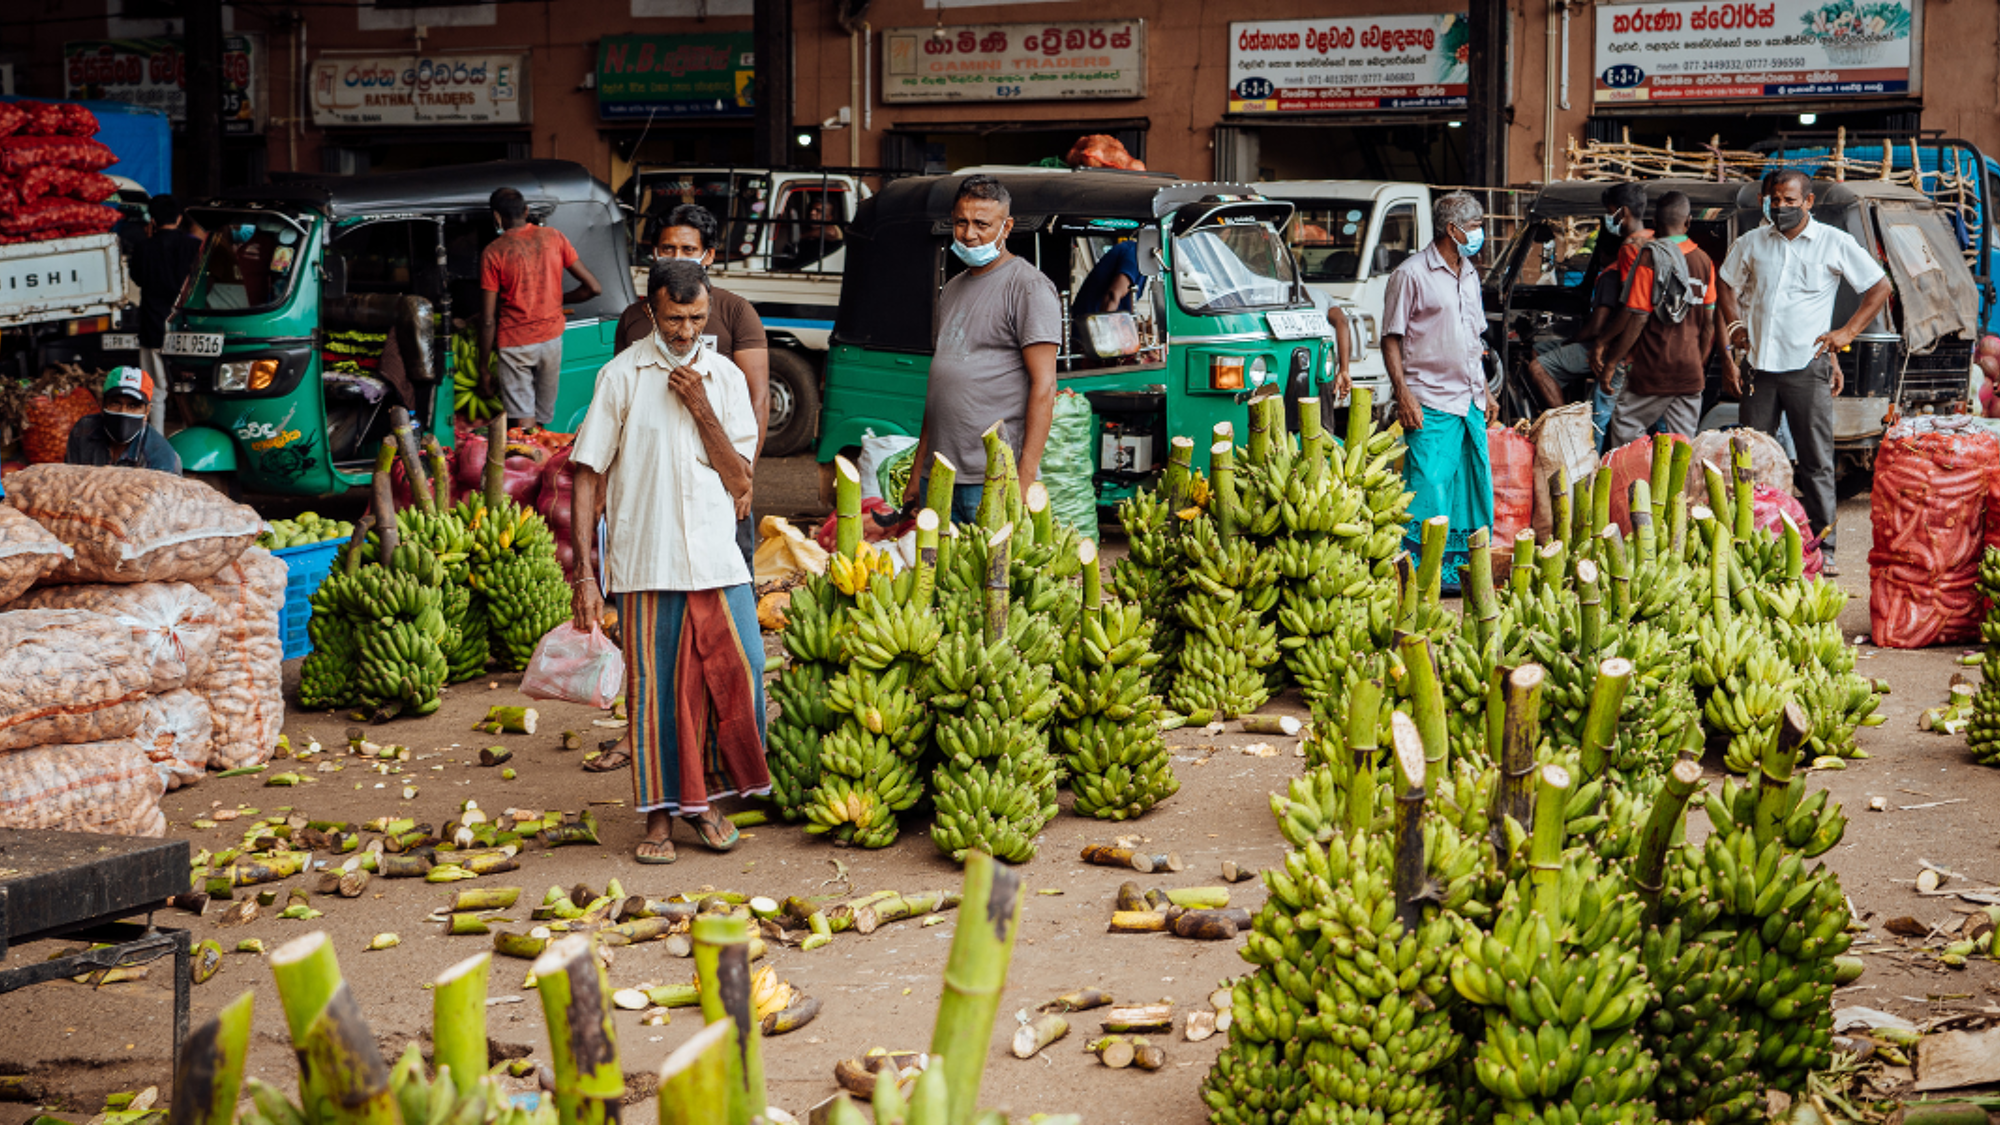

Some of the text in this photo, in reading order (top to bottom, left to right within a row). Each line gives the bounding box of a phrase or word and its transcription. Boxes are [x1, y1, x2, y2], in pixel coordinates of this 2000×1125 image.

[1613, 2, 1776, 34] කරුණා ස්ටෝර්ස්
[929, 56, 1112, 73] GAMINI TRADERS
[1607, 67, 1640, 84] E-3-7
[365, 91, 476, 107] RATHNA TRADERS
[0, 269, 78, 290] ISHI
